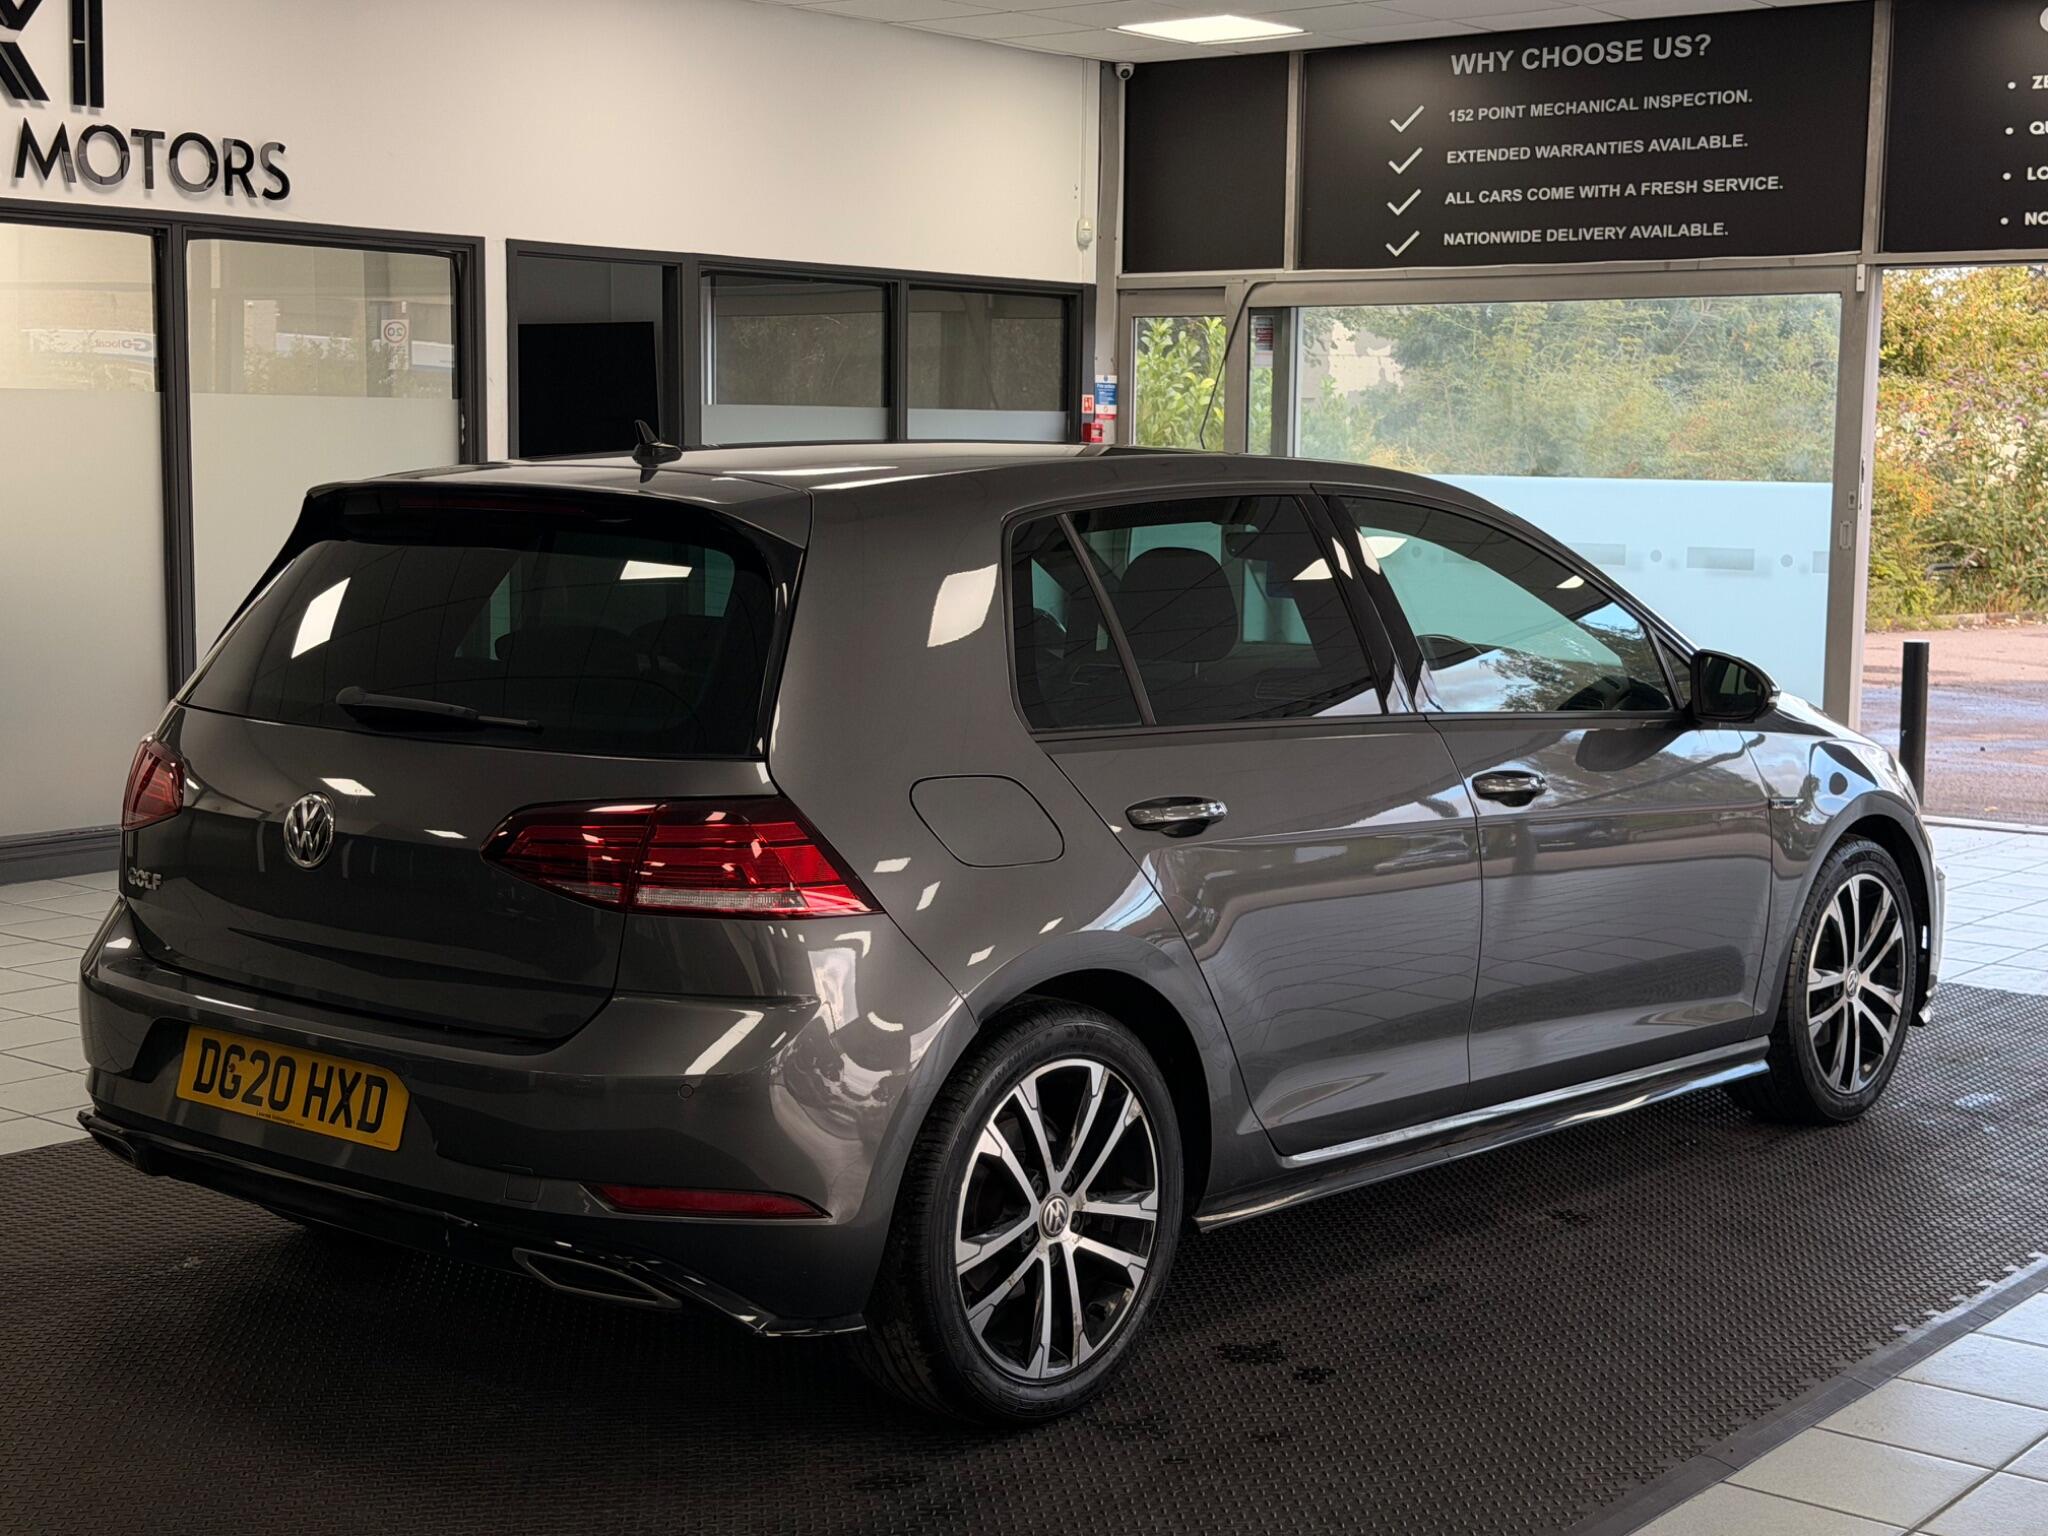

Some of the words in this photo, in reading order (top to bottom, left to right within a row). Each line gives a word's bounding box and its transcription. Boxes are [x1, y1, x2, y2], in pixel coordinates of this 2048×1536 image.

[1451, 49, 1515, 76] WHY
[1521, 39, 1644, 71] CHOOSE
[1653, 33, 1712, 60] US?
[1448, 108, 1474, 123] 152
[1477, 104, 1527, 121] POINT
[1529, 97, 1640, 118] MECHANICAL
[1643, 89, 1753, 110] INSPECTION.
[14, 117, 291, 202] MOTORS
[1446, 147, 1531, 165] EXTENDED
[1534, 140, 1645, 159] WARRANTIES
[1647, 133, 1749, 153] AVAILABLE.
[1444, 191, 1476, 205] ALL
[1478, 189, 1523, 204] CARS
[1526, 186, 1576, 202] COME
[1578, 183, 1621, 199] WITH
[1623, 183, 1638, 197] A
[1640, 180, 1698, 196] FRESH
[1701, 176, 1784, 194] SERVICE.
[1443, 229, 1542, 246] NATIONWIDE
[1546, 226, 1628, 243] DELIVERY
[1629, 221, 1729, 240] AVAILABLE.
[192, 1037, 297, 1113] DG20
[301, 1061, 390, 1136] HXD
